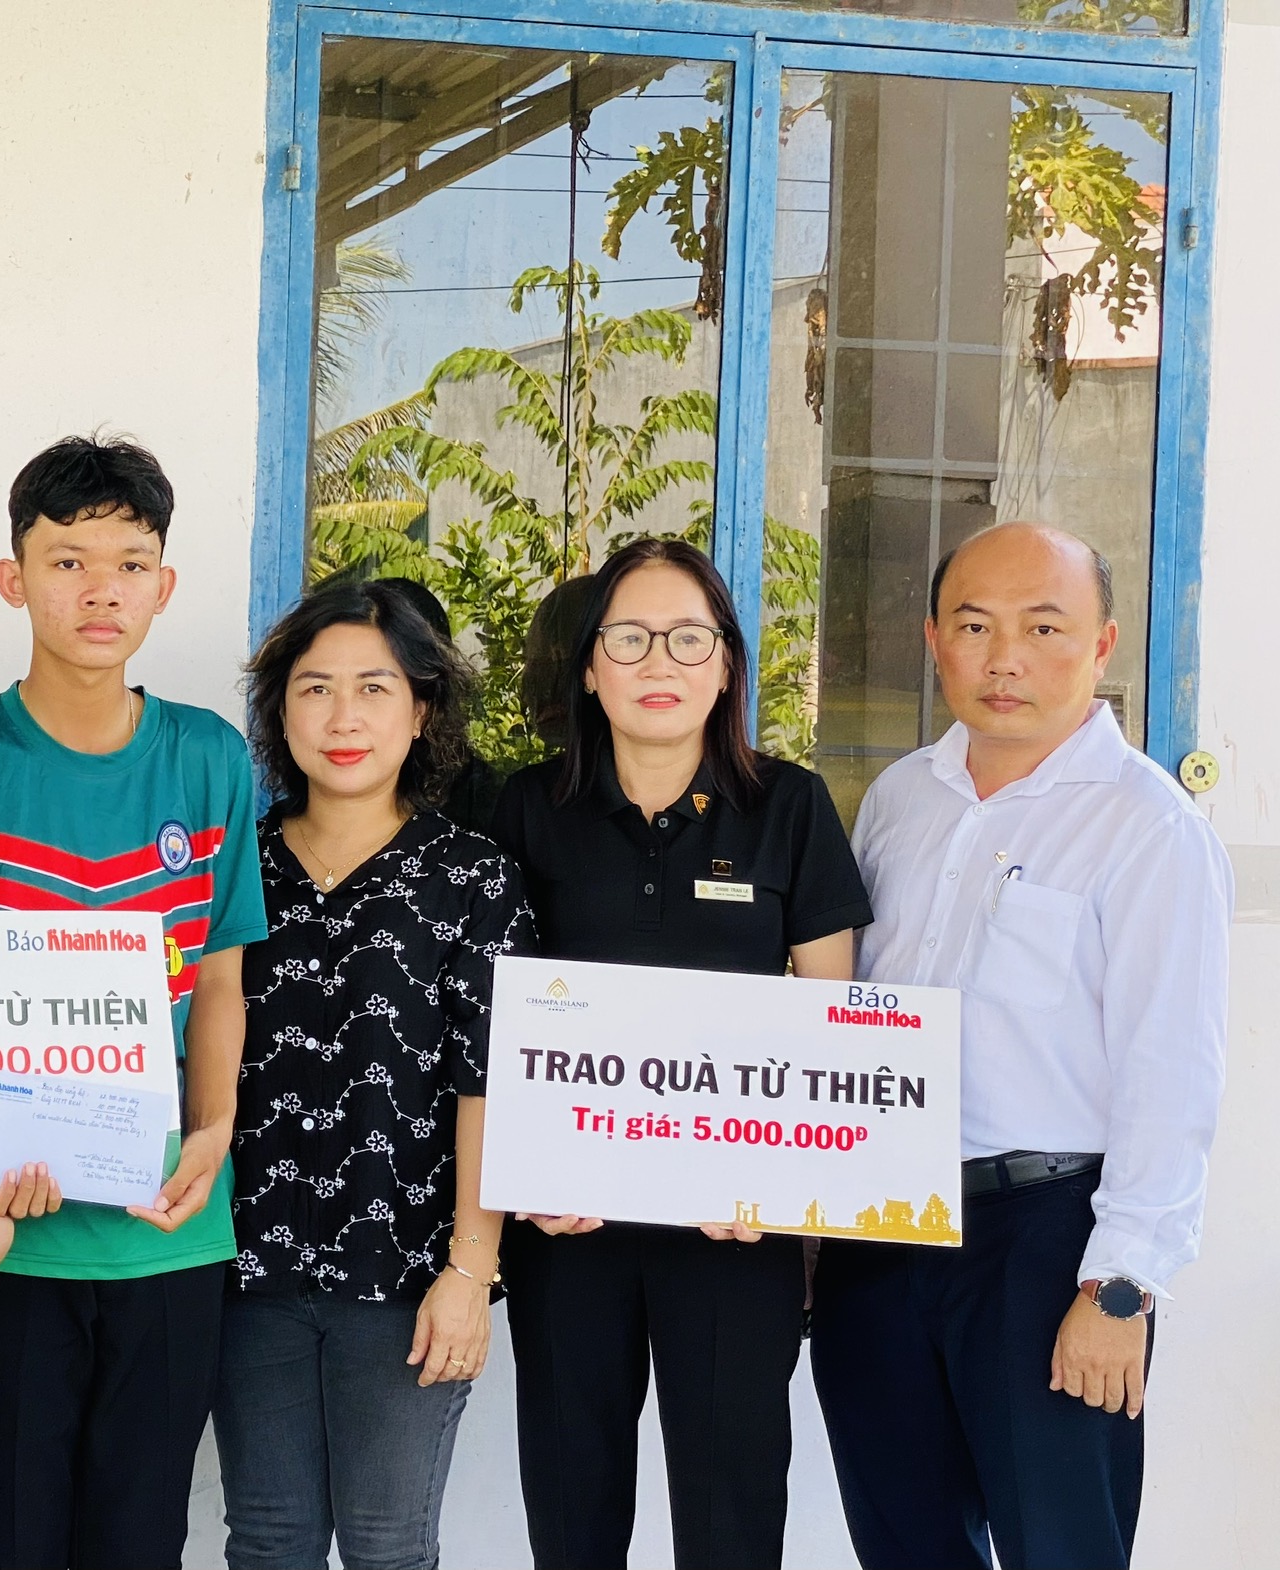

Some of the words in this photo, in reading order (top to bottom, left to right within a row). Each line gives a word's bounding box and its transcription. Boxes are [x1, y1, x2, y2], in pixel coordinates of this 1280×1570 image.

[7, 930, 44, 952] Báo
[43, 990, 148, 1031] THIỆN
[526, 997, 559, 1006] CHAMPA
[560, 1000, 589, 1008] ISLAND
[848, 985, 898, 1010] Báo
[519, 1047, 626, 1088] TRAO
[639, 1053, 719, 1096] QUÀ
[733, 1057, 791, 1099] TỪ
[802, 1065, 925, 1114] THIỆN
[571, 1105, 615, 1140] Trị
[626, 1111, 681, 1141] giá:
